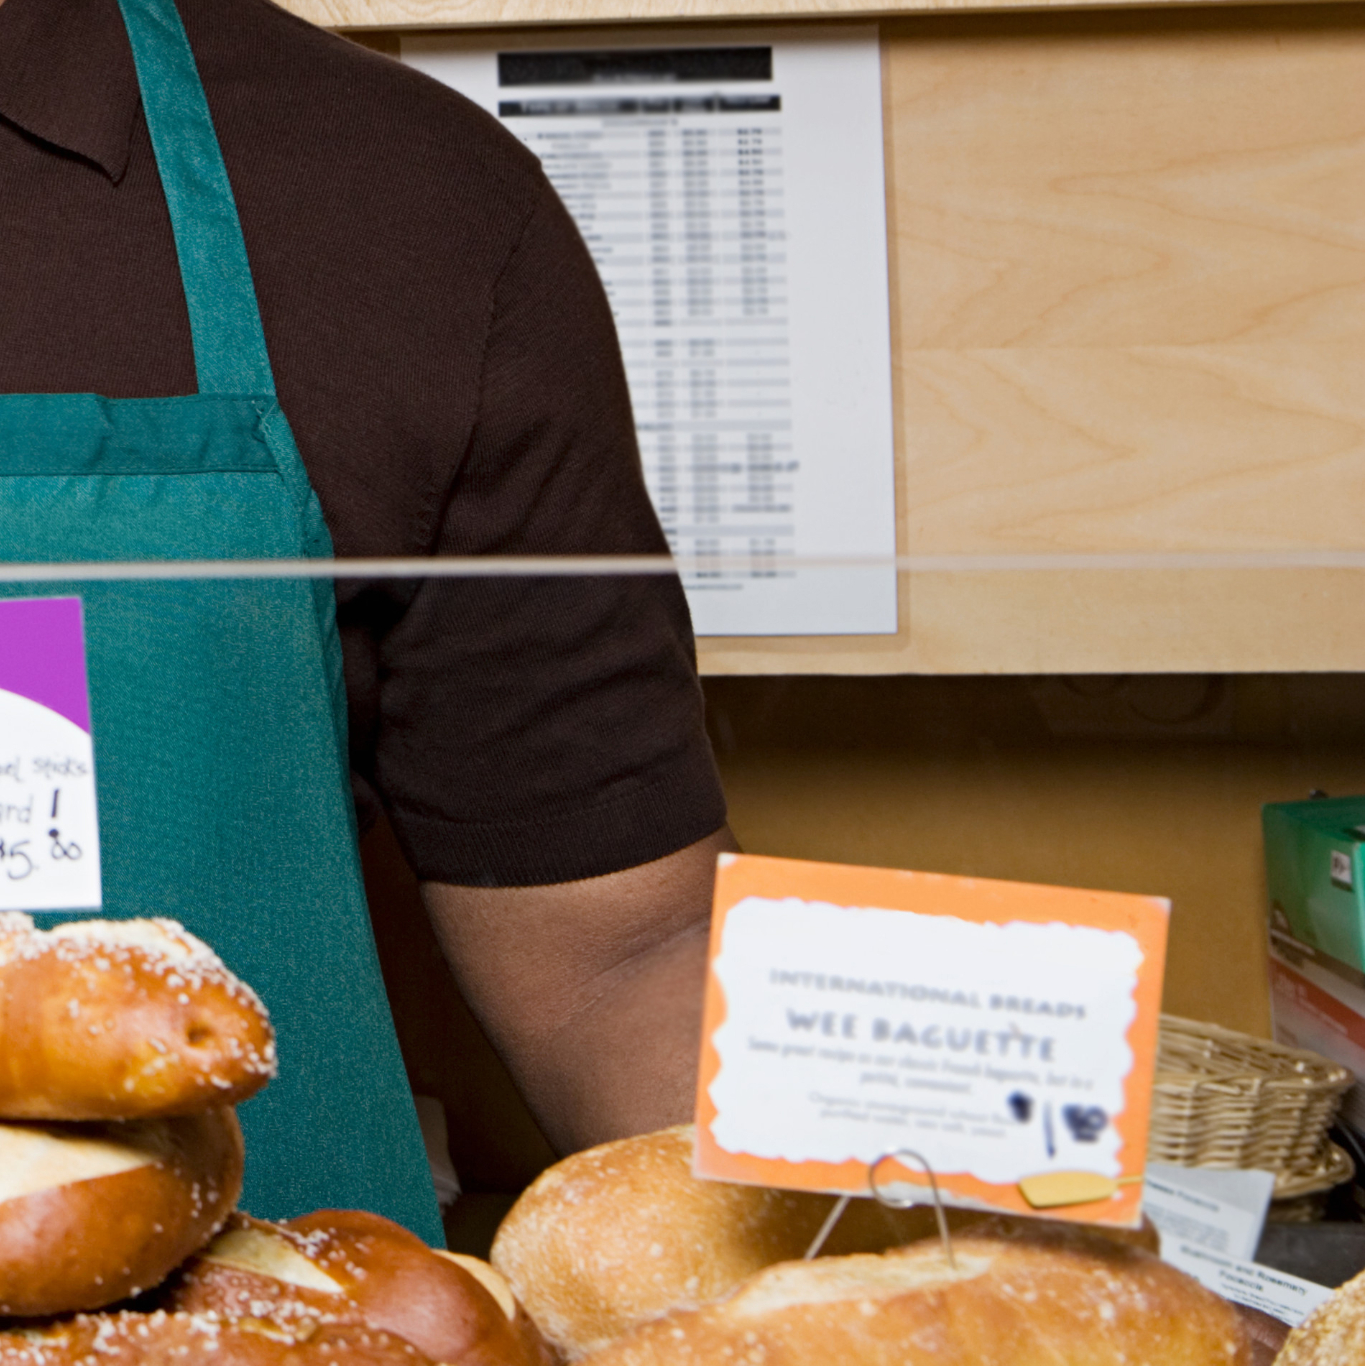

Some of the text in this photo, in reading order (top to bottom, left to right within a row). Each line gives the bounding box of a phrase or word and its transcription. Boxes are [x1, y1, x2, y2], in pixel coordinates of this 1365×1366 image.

[769, 968, 1088, 1021] INTERNATIONAL BREADS
[785, 1008, 1057, 1062] WEE BAGUETTE
